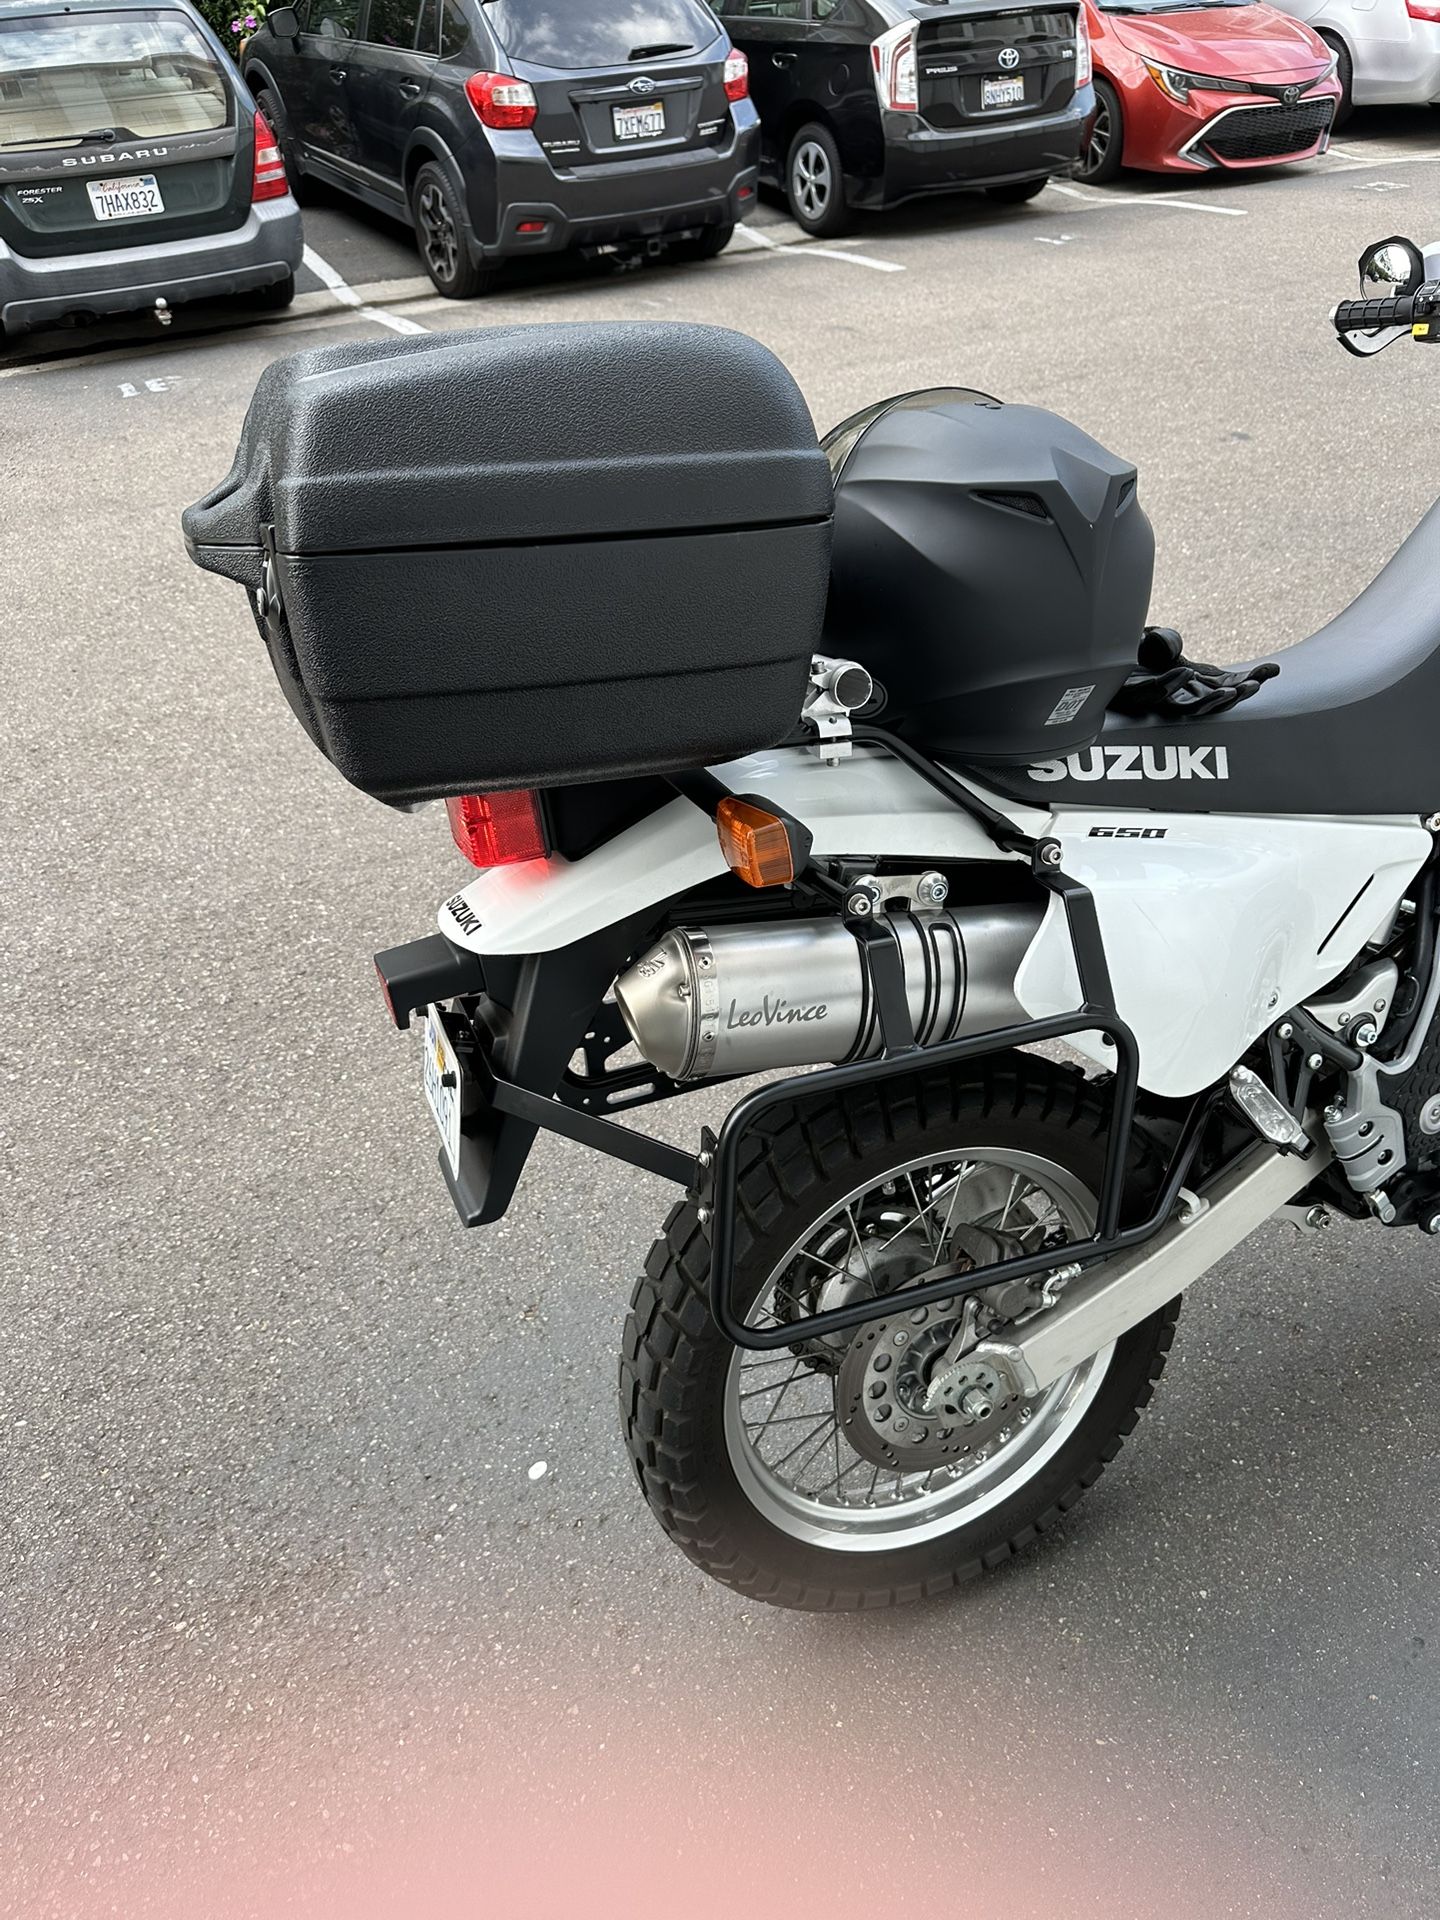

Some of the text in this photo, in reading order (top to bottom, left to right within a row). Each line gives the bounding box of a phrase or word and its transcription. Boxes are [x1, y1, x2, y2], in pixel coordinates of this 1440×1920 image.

[62, 147, 168, 167] SUBARU
[17, 186, 62, 196] FORESTER
[102, 181, 142, 193] California
[95, 189, 158, 214] 7HAX832
[1027, 746, 1229, 782] SUZUKI
[1088, 826, 1168, 839] 650
[446, 894, 482, 936] SUZUKI
[727, 994, 828, 1030] LeoVince
